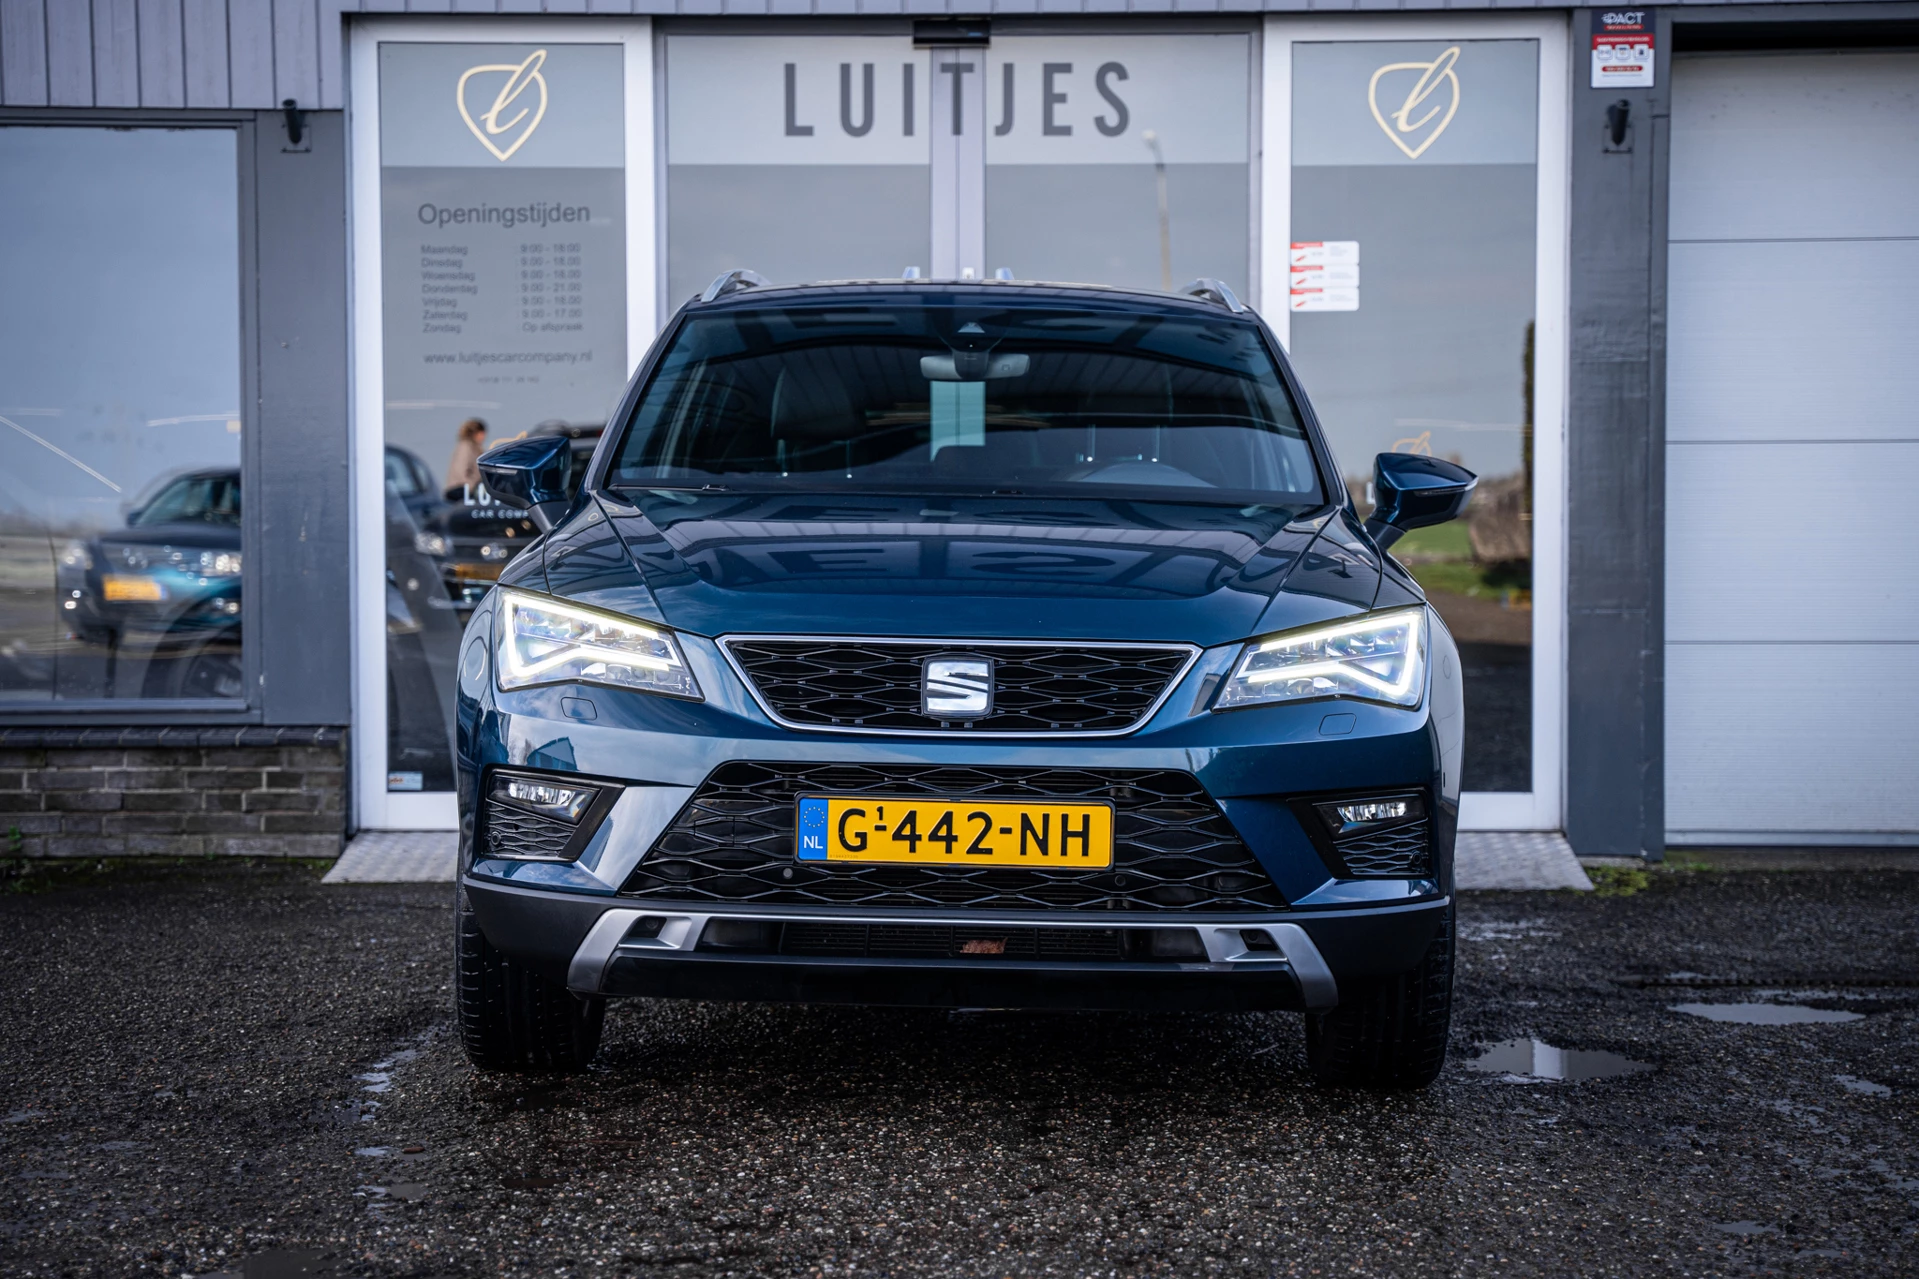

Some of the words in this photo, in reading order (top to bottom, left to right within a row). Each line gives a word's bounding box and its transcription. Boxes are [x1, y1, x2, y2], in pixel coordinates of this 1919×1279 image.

[784, 61, 1130, 138] LUITJES
[418, 202, 591, 228] Openingstijden
[803, 835, 823, 849] NL
